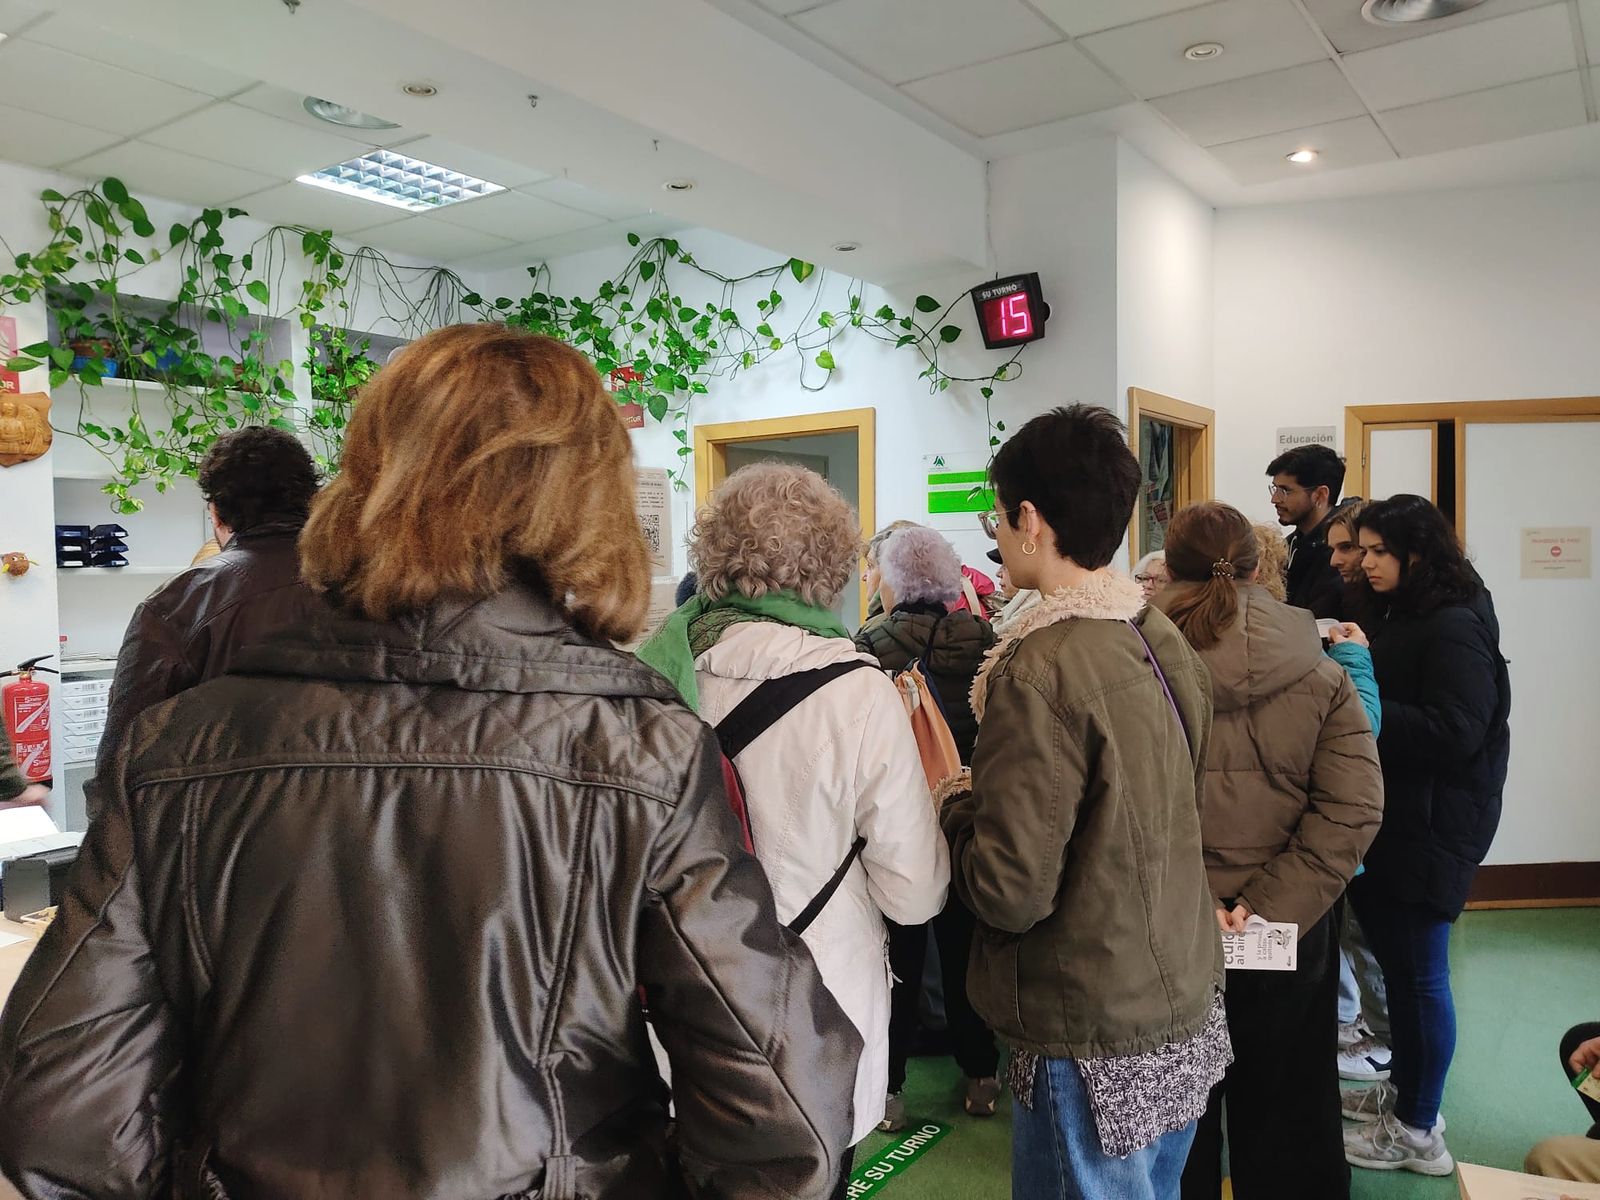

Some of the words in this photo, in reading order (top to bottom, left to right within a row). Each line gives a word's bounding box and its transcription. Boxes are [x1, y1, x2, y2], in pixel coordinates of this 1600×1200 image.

[982, 291, 992, 299] SU
[993, 284, 1018, 296] TURNO
[1001, 294, 1028, 337] 15
[1279, 433, 1333, 444] Educación
[1235, 955, 1245, 965] al
[846, 1178, 874, 1200] RE
[864, 1161, 894, 1181] SU
[885, 1124, 941, 1162] TURNO
